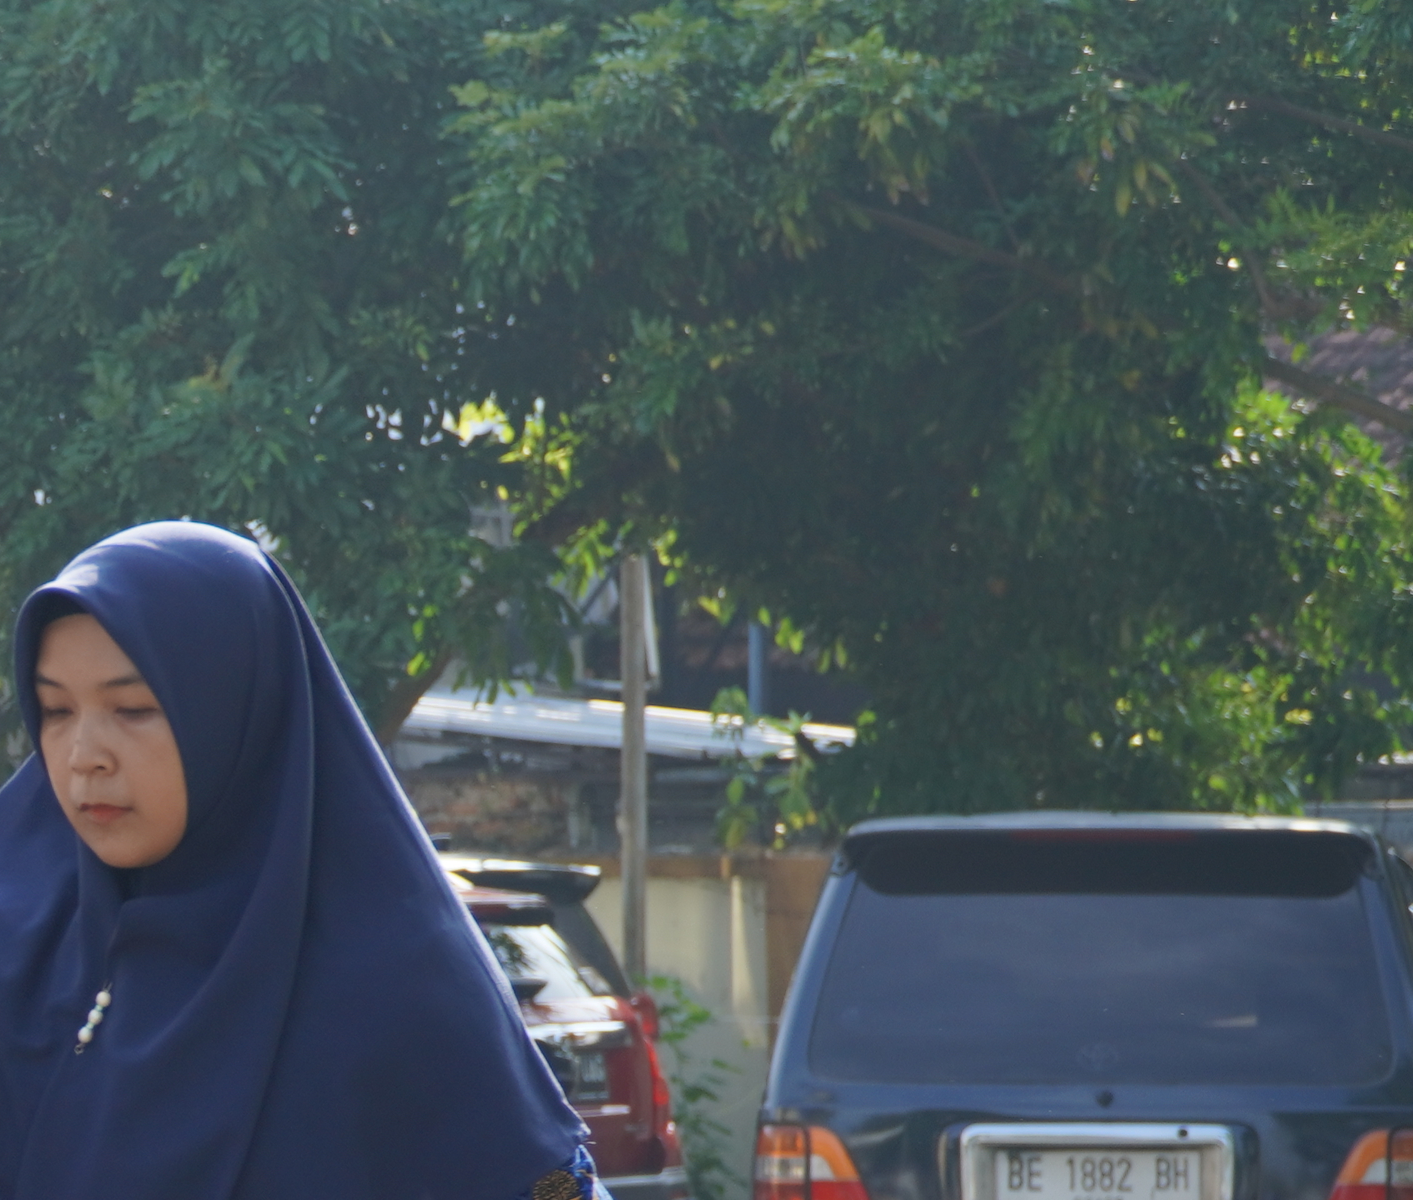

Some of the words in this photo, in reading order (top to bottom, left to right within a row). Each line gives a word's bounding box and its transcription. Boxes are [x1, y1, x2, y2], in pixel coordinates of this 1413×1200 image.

[1007, 1156, 1042, 1192] BE
[1066, 1156, 1133, 1192] 1882
[1155, 1156, 1189, 1192] BH
